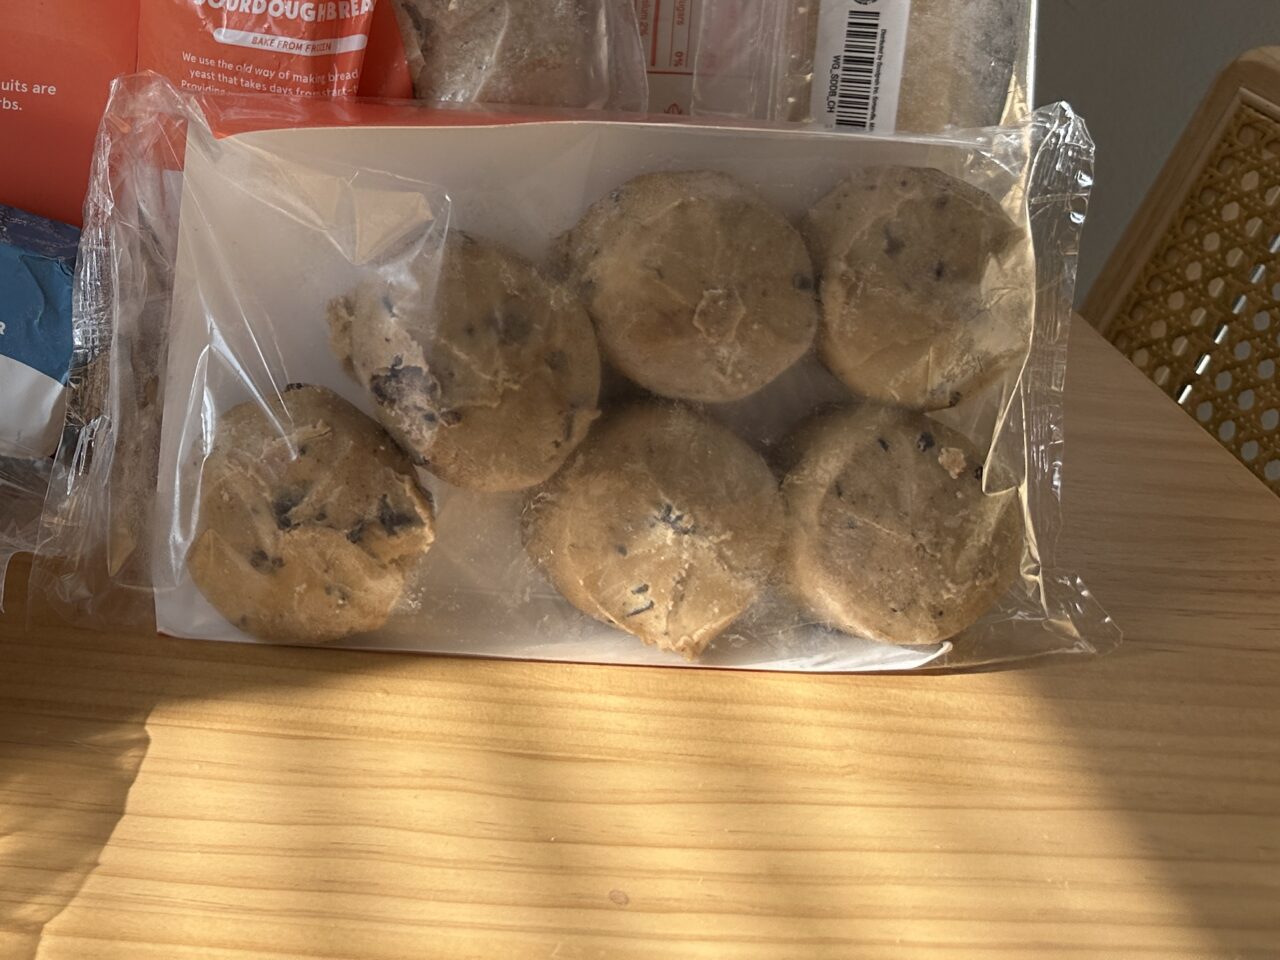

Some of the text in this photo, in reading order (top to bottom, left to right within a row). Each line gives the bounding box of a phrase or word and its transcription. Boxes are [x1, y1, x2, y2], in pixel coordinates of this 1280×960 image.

[251, 36, 275, 47] BAKE
[277, 40, 303, 51] FROM
[182, 51, 197, 64] We
[199, 56, 216, 67] use
[217, 59, 234, 71] the
[235, 63, 253, 74] old
[254, 67, 276, 80] way
[278, 69, 291, 80] of
[31, 83, 57, 96] are
[189, 69, 293, 97] yeast that takes days
[826, 54, 841, 114] WG_SDDB_CH
